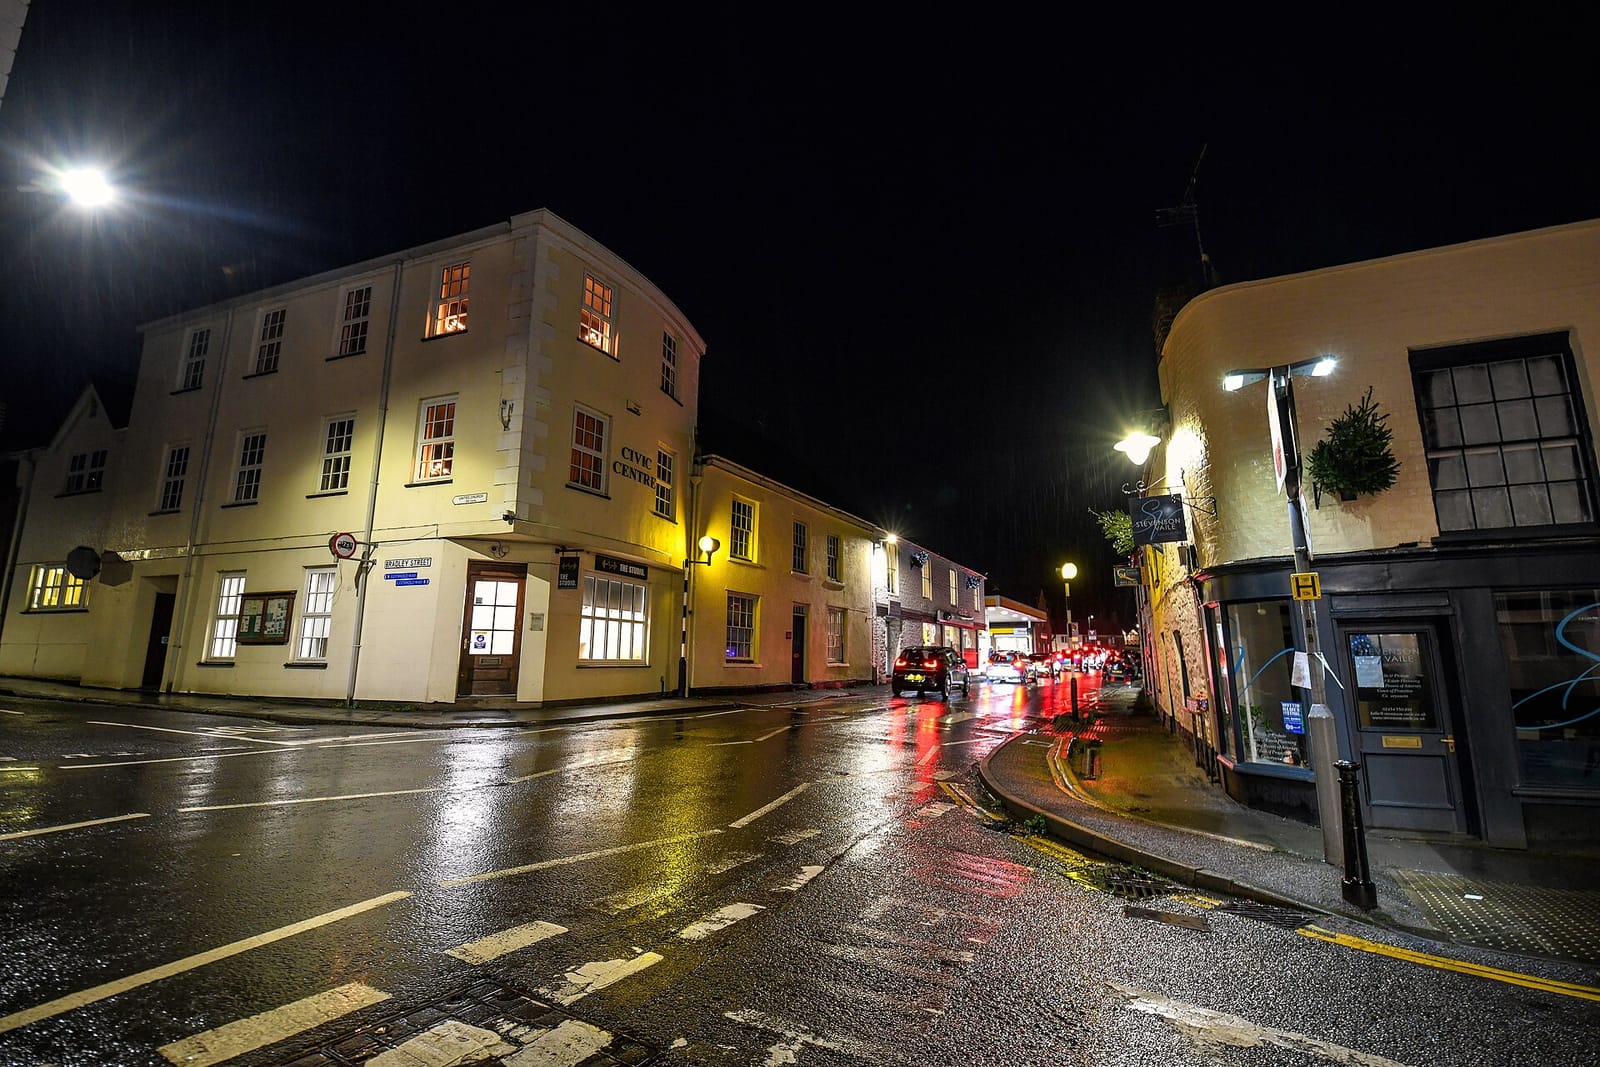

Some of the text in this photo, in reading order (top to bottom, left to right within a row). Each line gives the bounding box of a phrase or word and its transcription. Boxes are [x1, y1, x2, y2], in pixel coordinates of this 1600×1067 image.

[622, 446, 652, 470] CIVIC
[613, 461, 656, 489] CENTRE
[1135, 518, 1181, 528] STEVENSON
[385, 559, 430, 568] BRADLEY STREET
[620, 563, 629, 572] THE
[1385, 655, 1415, 663] VAILE
